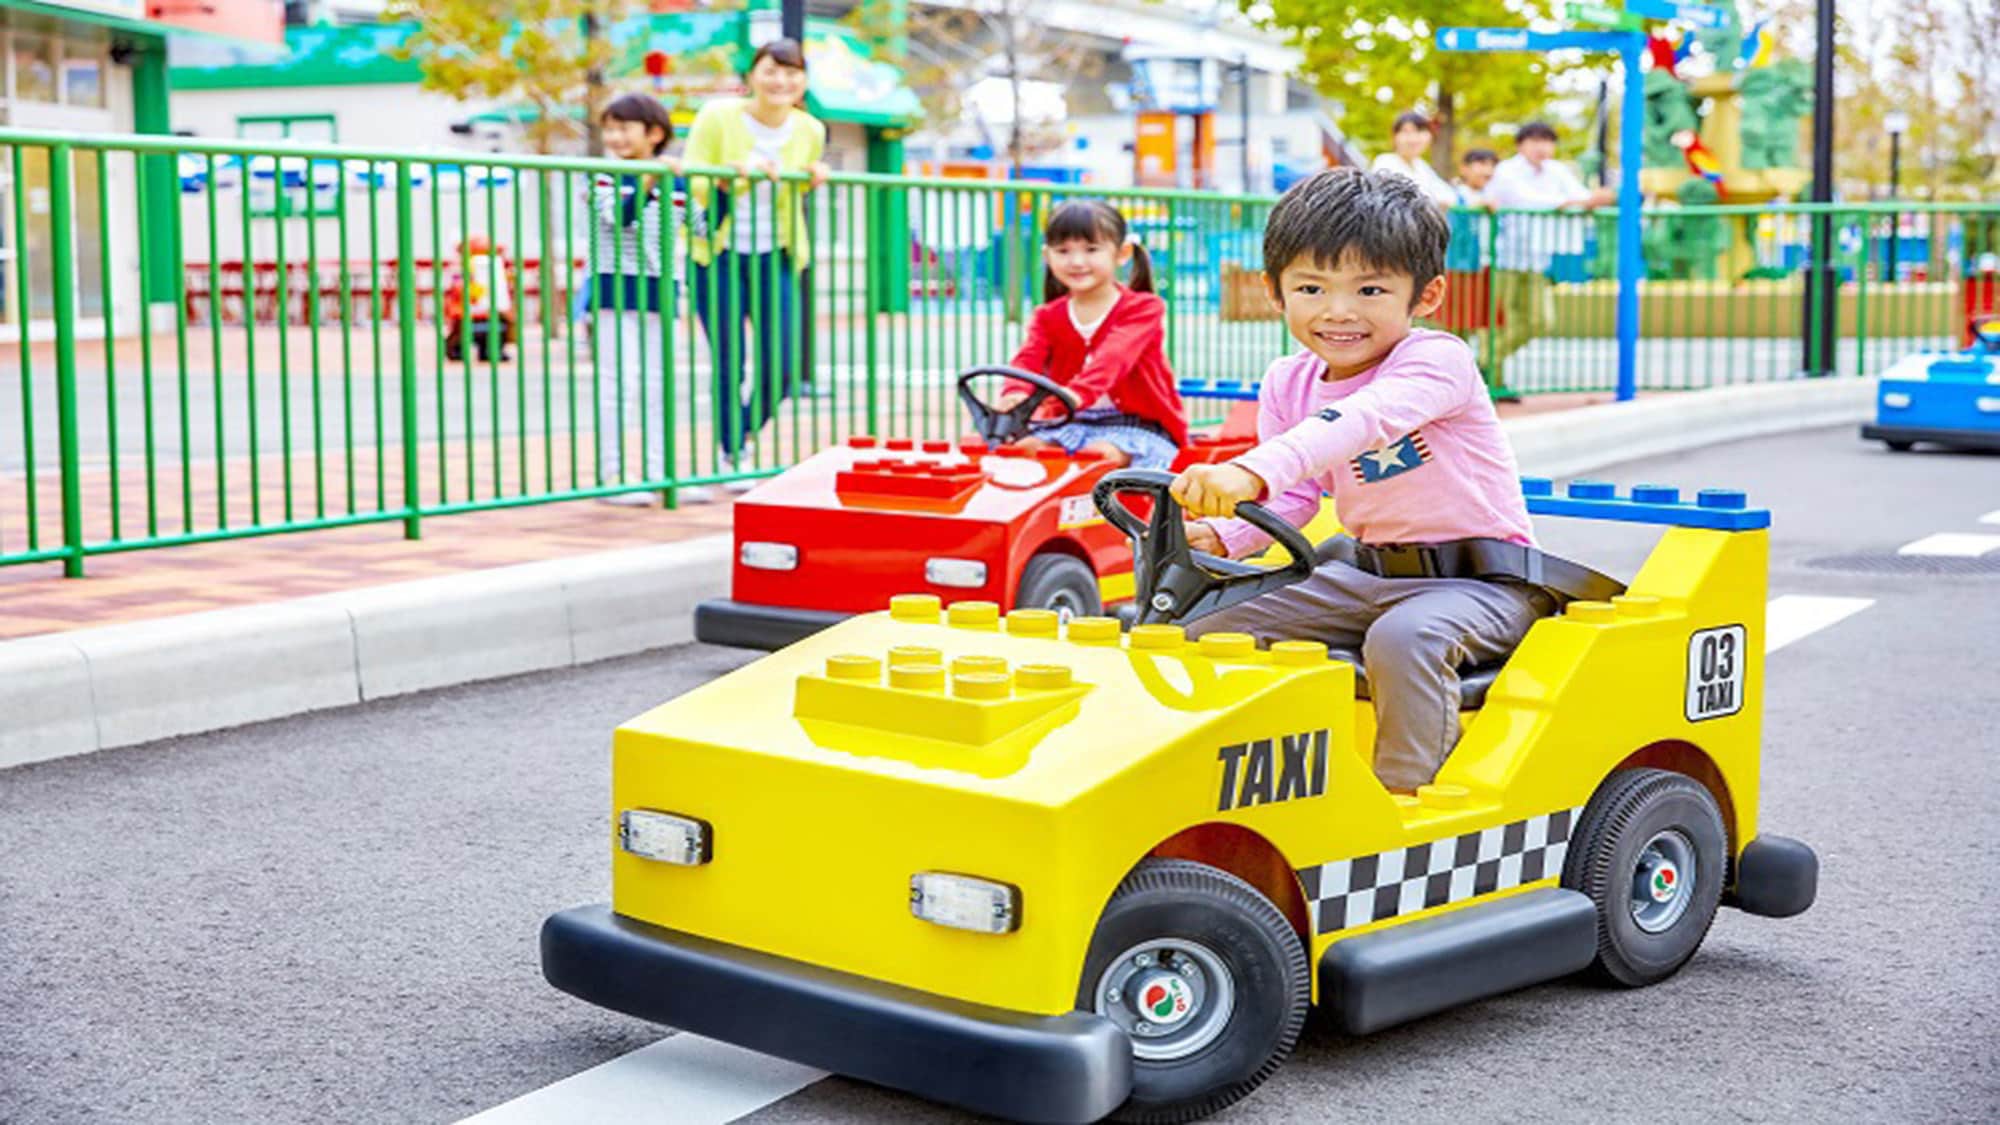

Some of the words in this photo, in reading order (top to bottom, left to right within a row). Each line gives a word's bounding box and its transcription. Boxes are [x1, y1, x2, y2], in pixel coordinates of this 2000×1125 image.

[1700, 632, 1735, 682] 03
[1697, 680, 1734, 713] TAXI
[1217, 729, 1329, 812] TAXI
